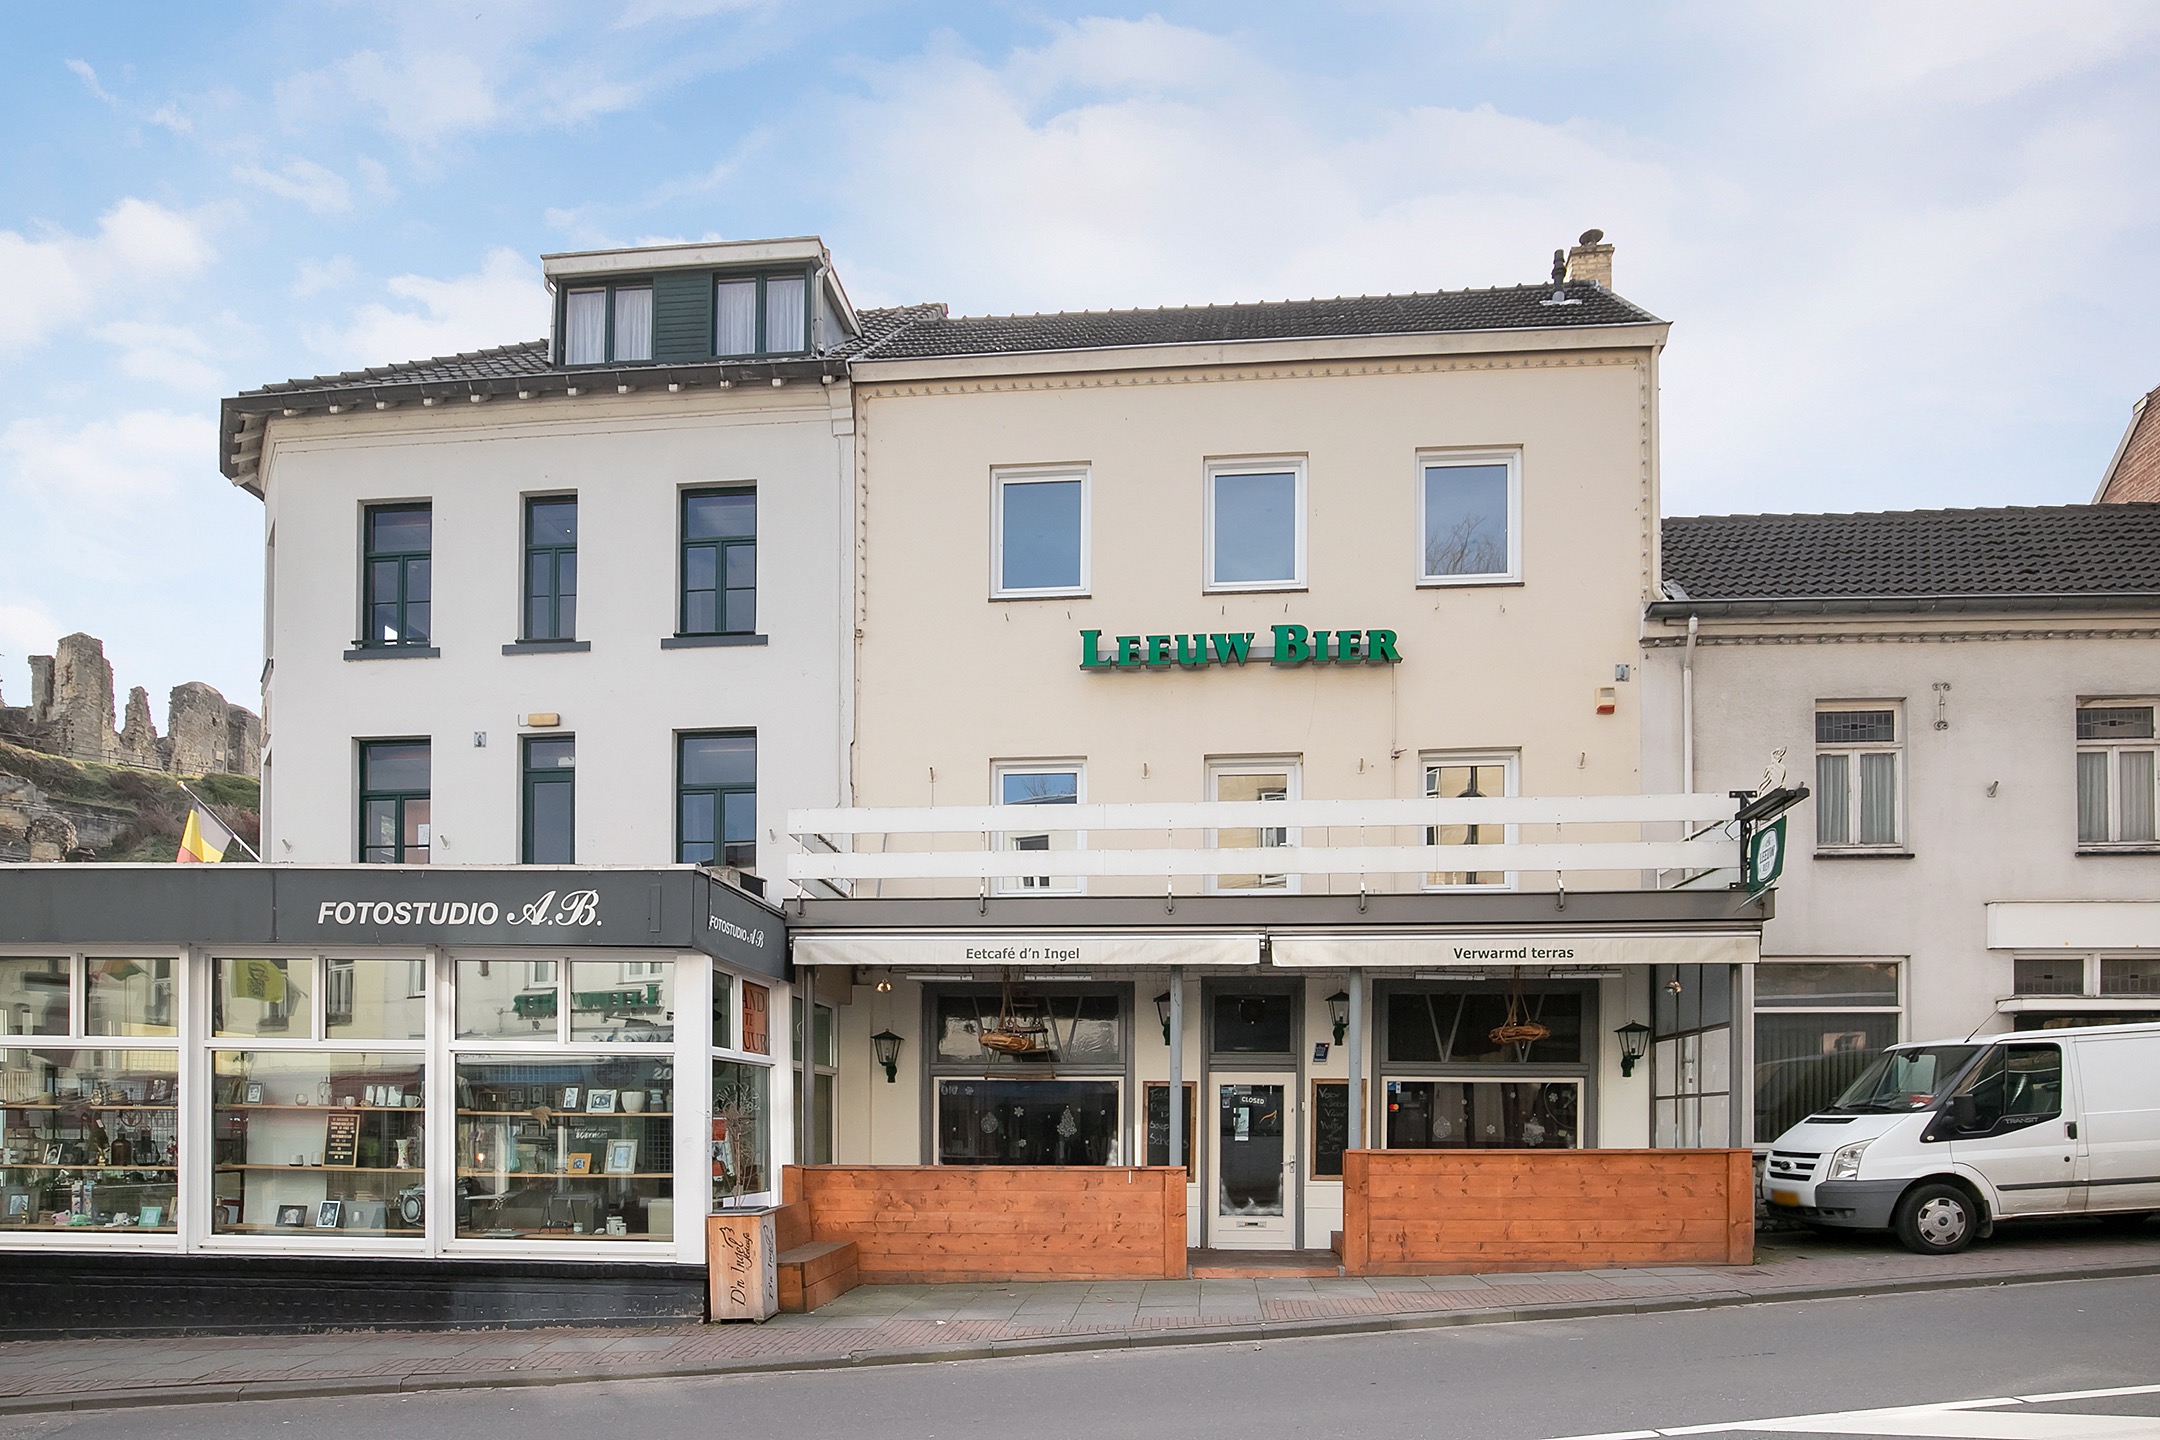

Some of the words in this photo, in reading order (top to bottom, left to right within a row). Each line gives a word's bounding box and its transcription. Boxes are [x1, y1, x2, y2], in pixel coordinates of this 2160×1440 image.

[317, 901, 499, 925] FOTOSTUDIO
[506, 889, 603, 926] A.B.
[709, 914, 747, 942] FOTOSTUDIO
[966, 947, 1015, 959] Eetcafé
[1044, 947, 1080, 961] Ingel
[1453, 946, 1527, 959] Verwarmd
[1531, 947, 1574, 958] terras
[1241, 1096, 1265, 1105] CLOSED
